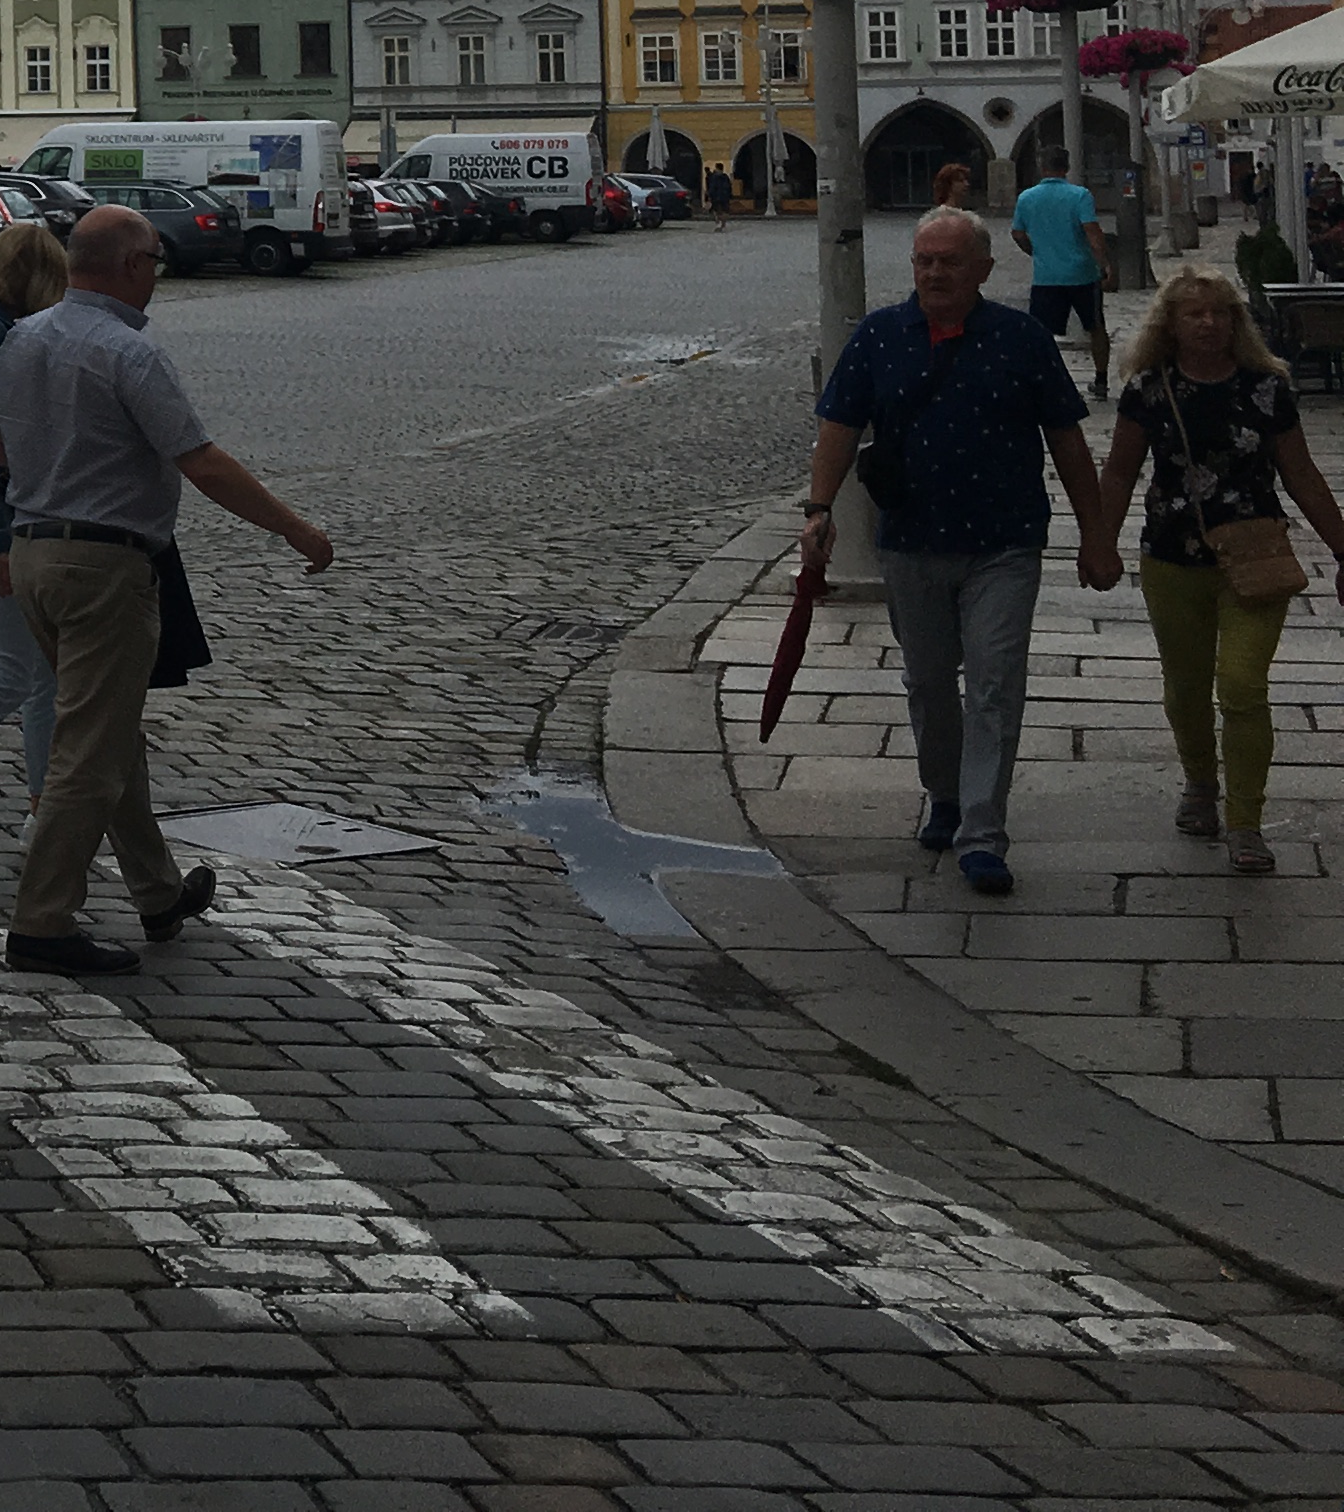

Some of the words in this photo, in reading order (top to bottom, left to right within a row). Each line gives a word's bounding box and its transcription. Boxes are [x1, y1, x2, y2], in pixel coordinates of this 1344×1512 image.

[1272, 63, 1344, 96] Coca-Co
[85, 134, 154, 144] SKLOCENTRUM
[499, 139, 520, 149] 606
[523, 139, 544, 149] 079
[547, 139, 569, 149] 079
[91, 154, 136, 169] SKLO
[448, 153, 521, 167] PŮJČOVNA
[526, 155, 570, 179] CB
